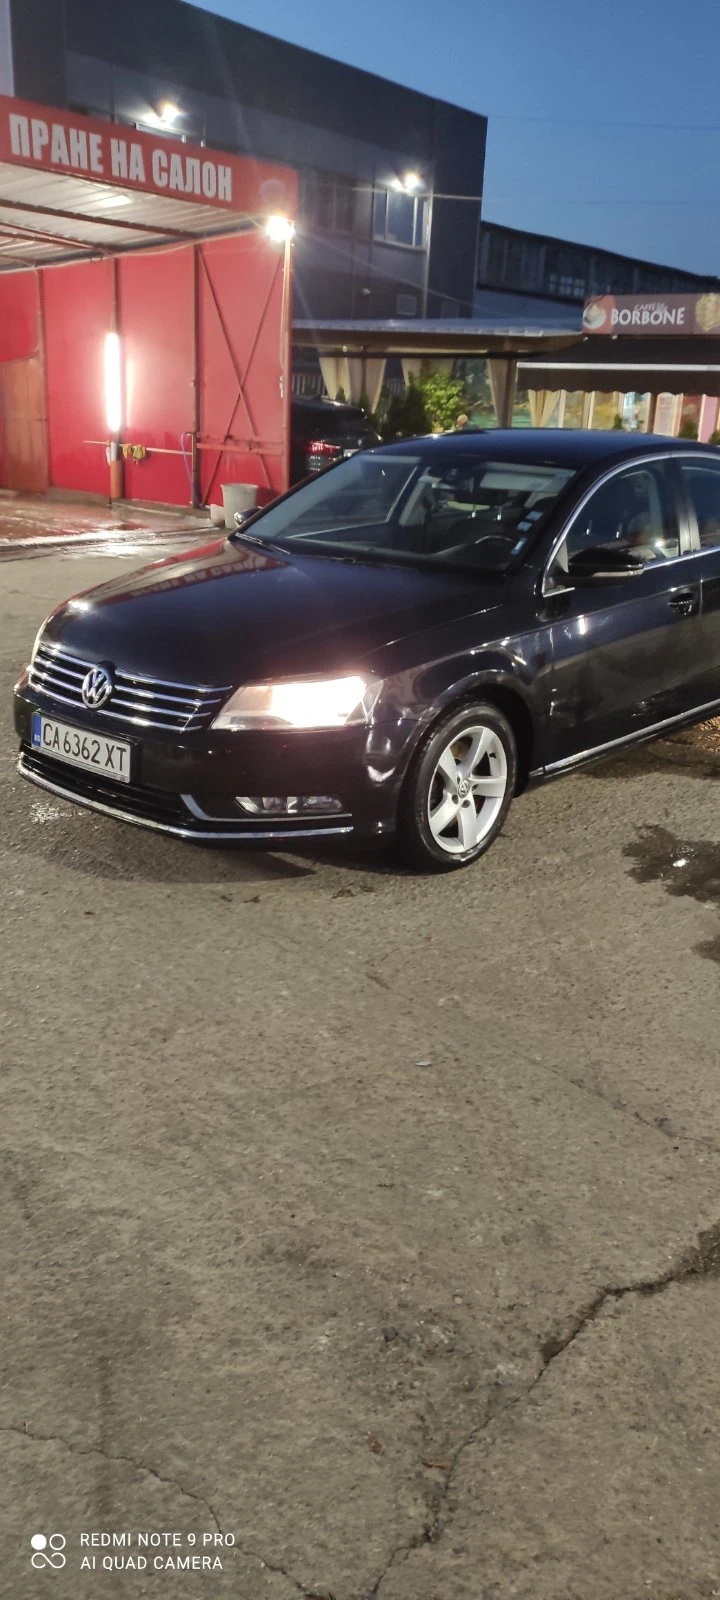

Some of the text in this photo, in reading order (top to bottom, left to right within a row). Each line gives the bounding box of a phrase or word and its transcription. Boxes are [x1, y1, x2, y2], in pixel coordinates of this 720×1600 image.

[9, 113, 232, 202] ПРАНЕ НА САЛОН
[611, 307, 685, 325] BORBONE
[43, 723, 127, 771] CA 6362 XT
